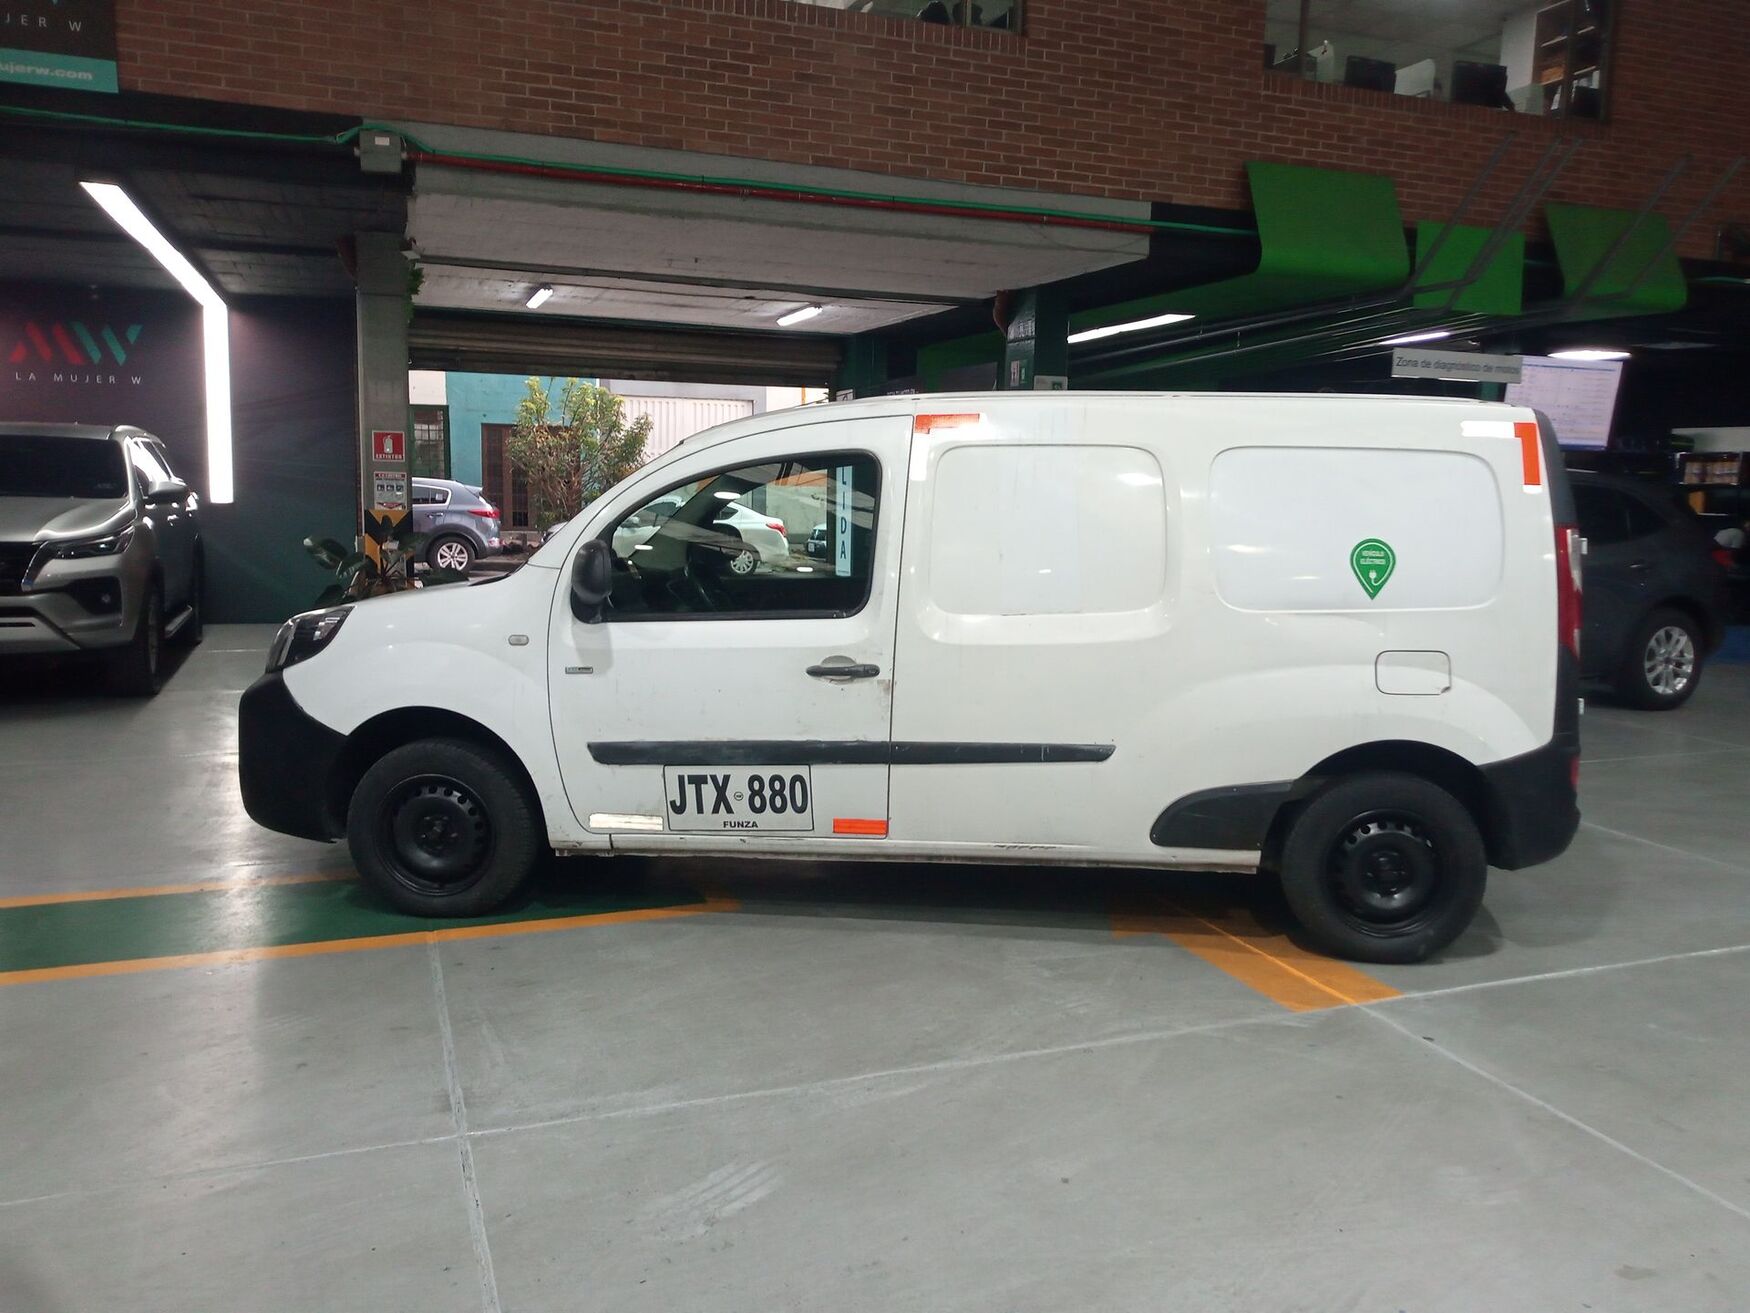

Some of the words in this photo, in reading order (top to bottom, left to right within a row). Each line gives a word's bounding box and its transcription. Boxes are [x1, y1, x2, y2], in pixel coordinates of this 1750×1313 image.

[68, 20, 82, 32] W
[1396, 356, 1419, 368] Zona
[1421, 359, 1432, 369] de
[15, 372, 37, 381] LA
[53, 373, 117, 385] MUJER
[131, 375, 142, 385] W
[669, 774, 735, 815] JTX
[747, 774, 809, 815] 880
[723, 820, 759, 829] FUNZA
